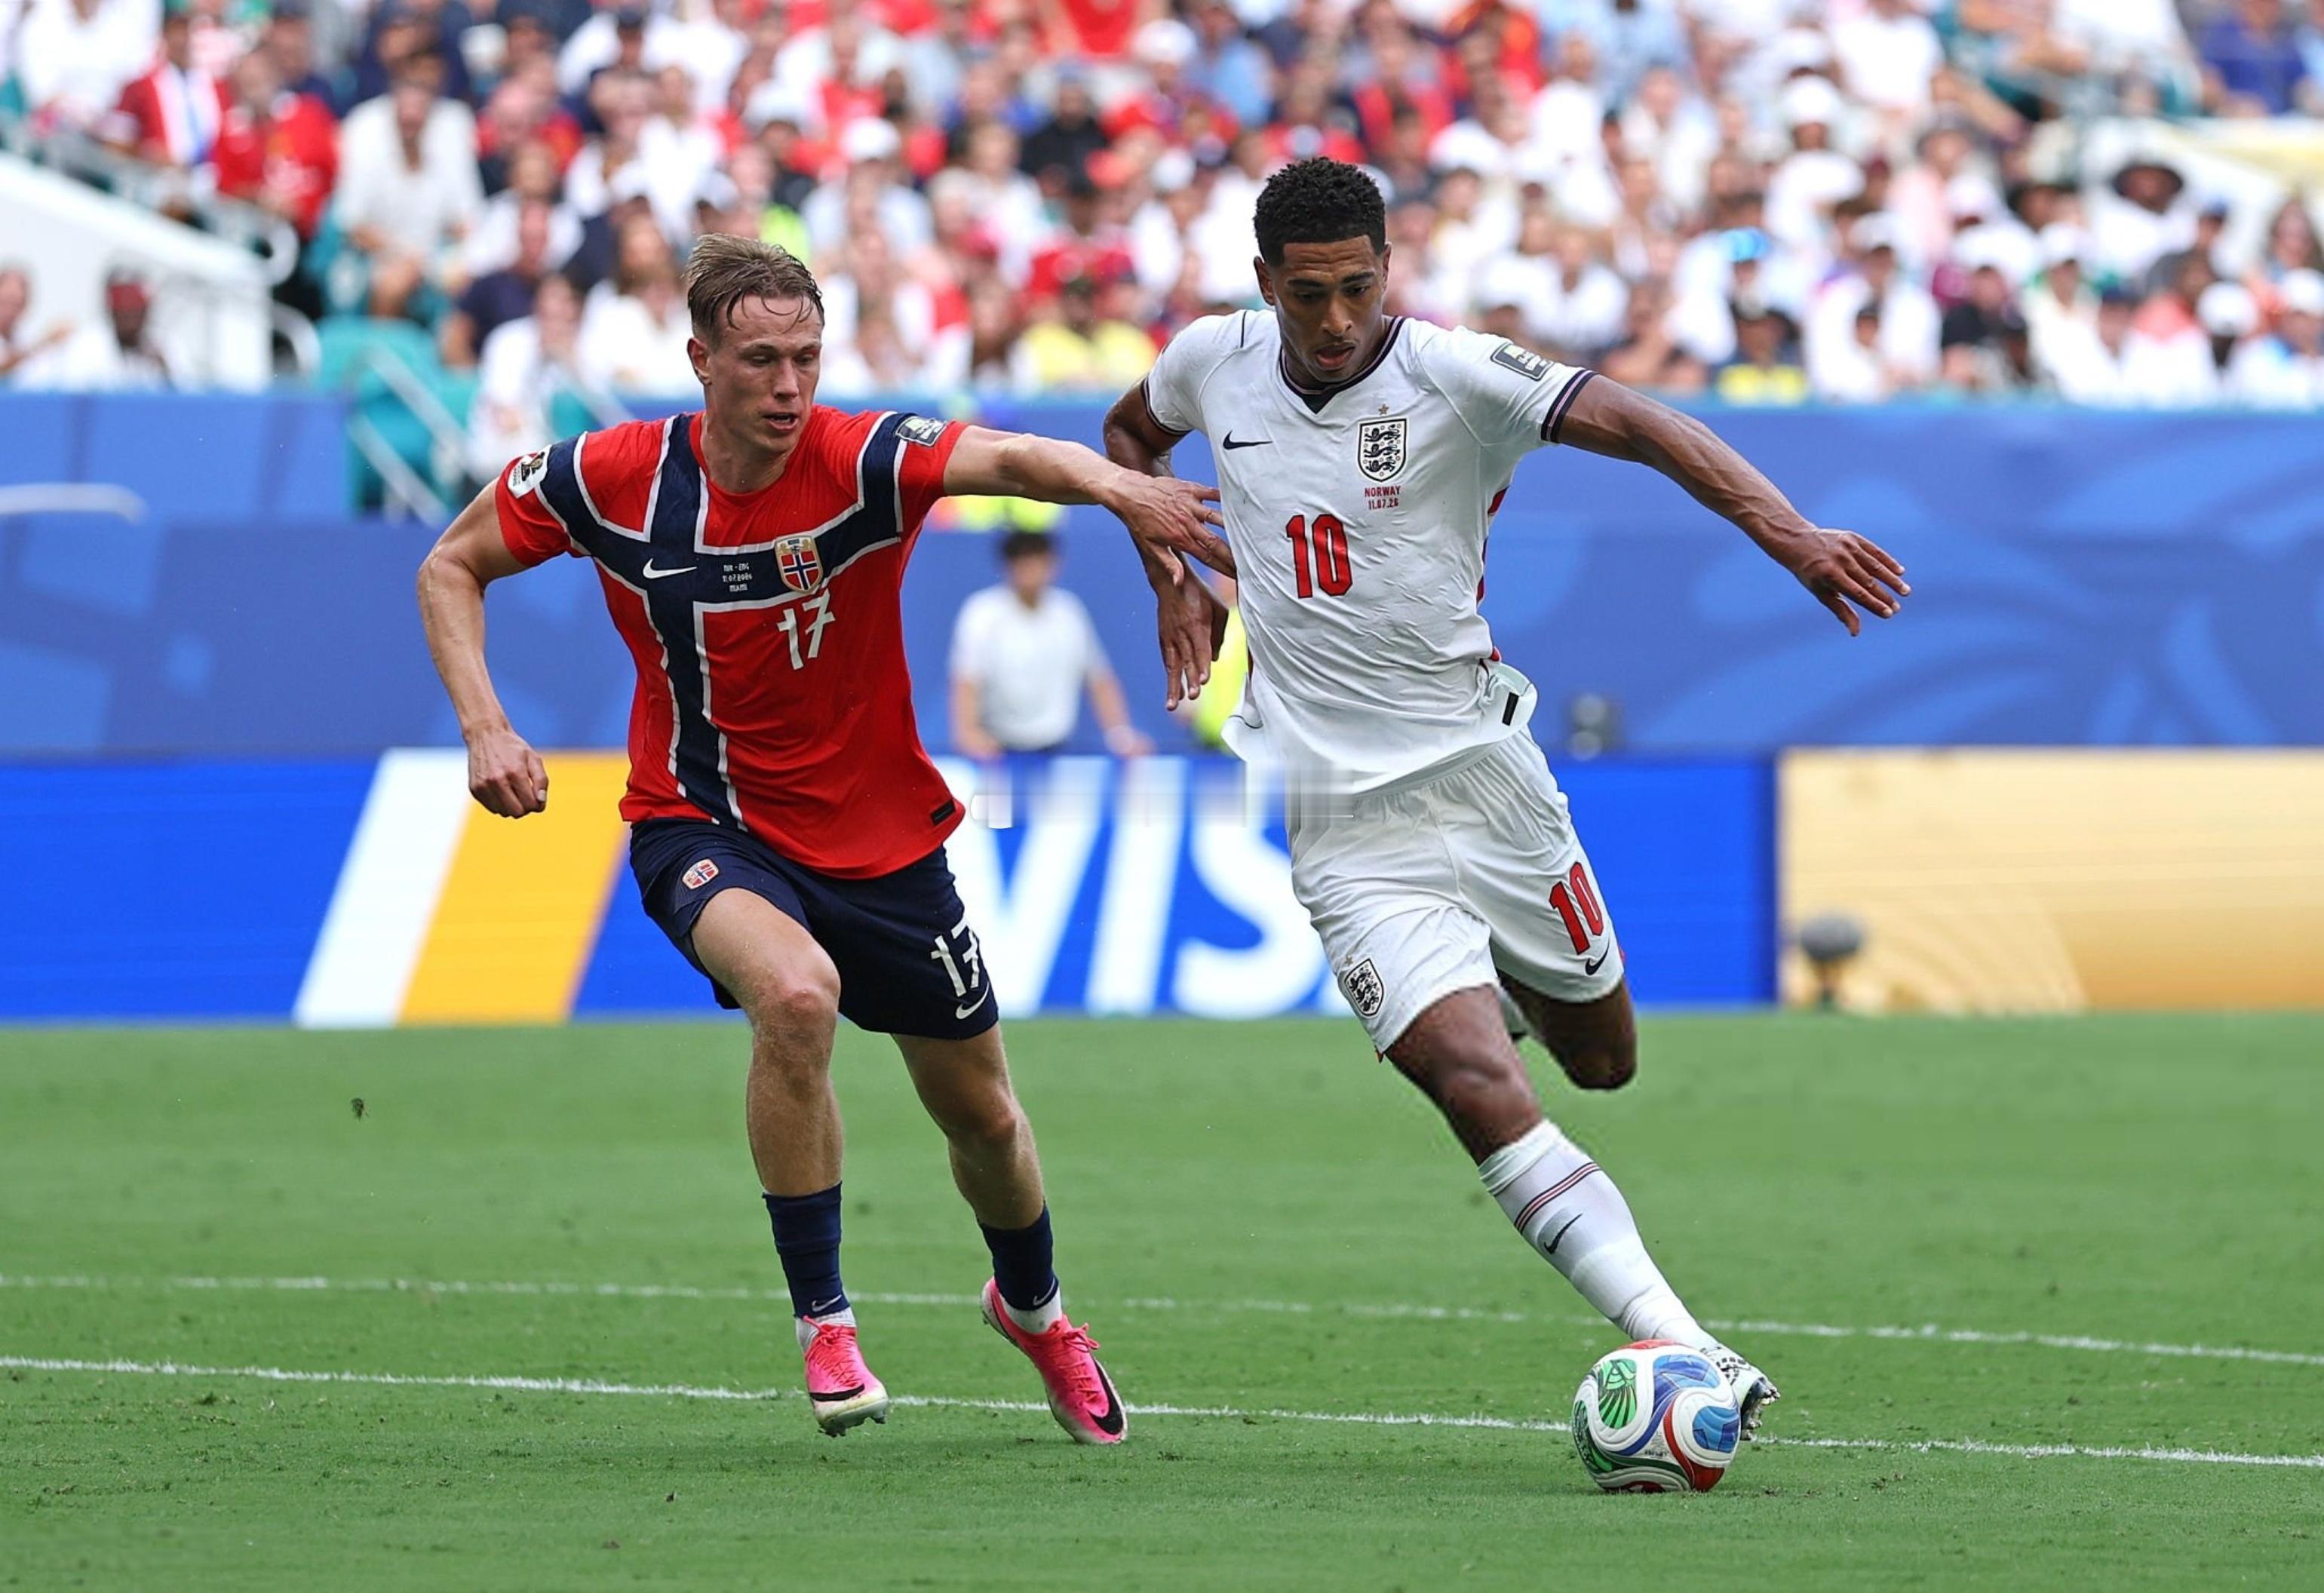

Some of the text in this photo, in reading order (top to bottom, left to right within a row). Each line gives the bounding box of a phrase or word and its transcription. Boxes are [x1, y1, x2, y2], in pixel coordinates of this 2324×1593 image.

[1364, 485, 1401, 498] NORWAY
[1368, 498, 1399, 510] 11.07.26
[1285, 514, 1352, 599] 10
[776, 588, 836, 671] 17
[929, 757, 1356, 1020] VIS
[1549, 861, 1604, 956] 10
[930, 919, 980, 997] 17
